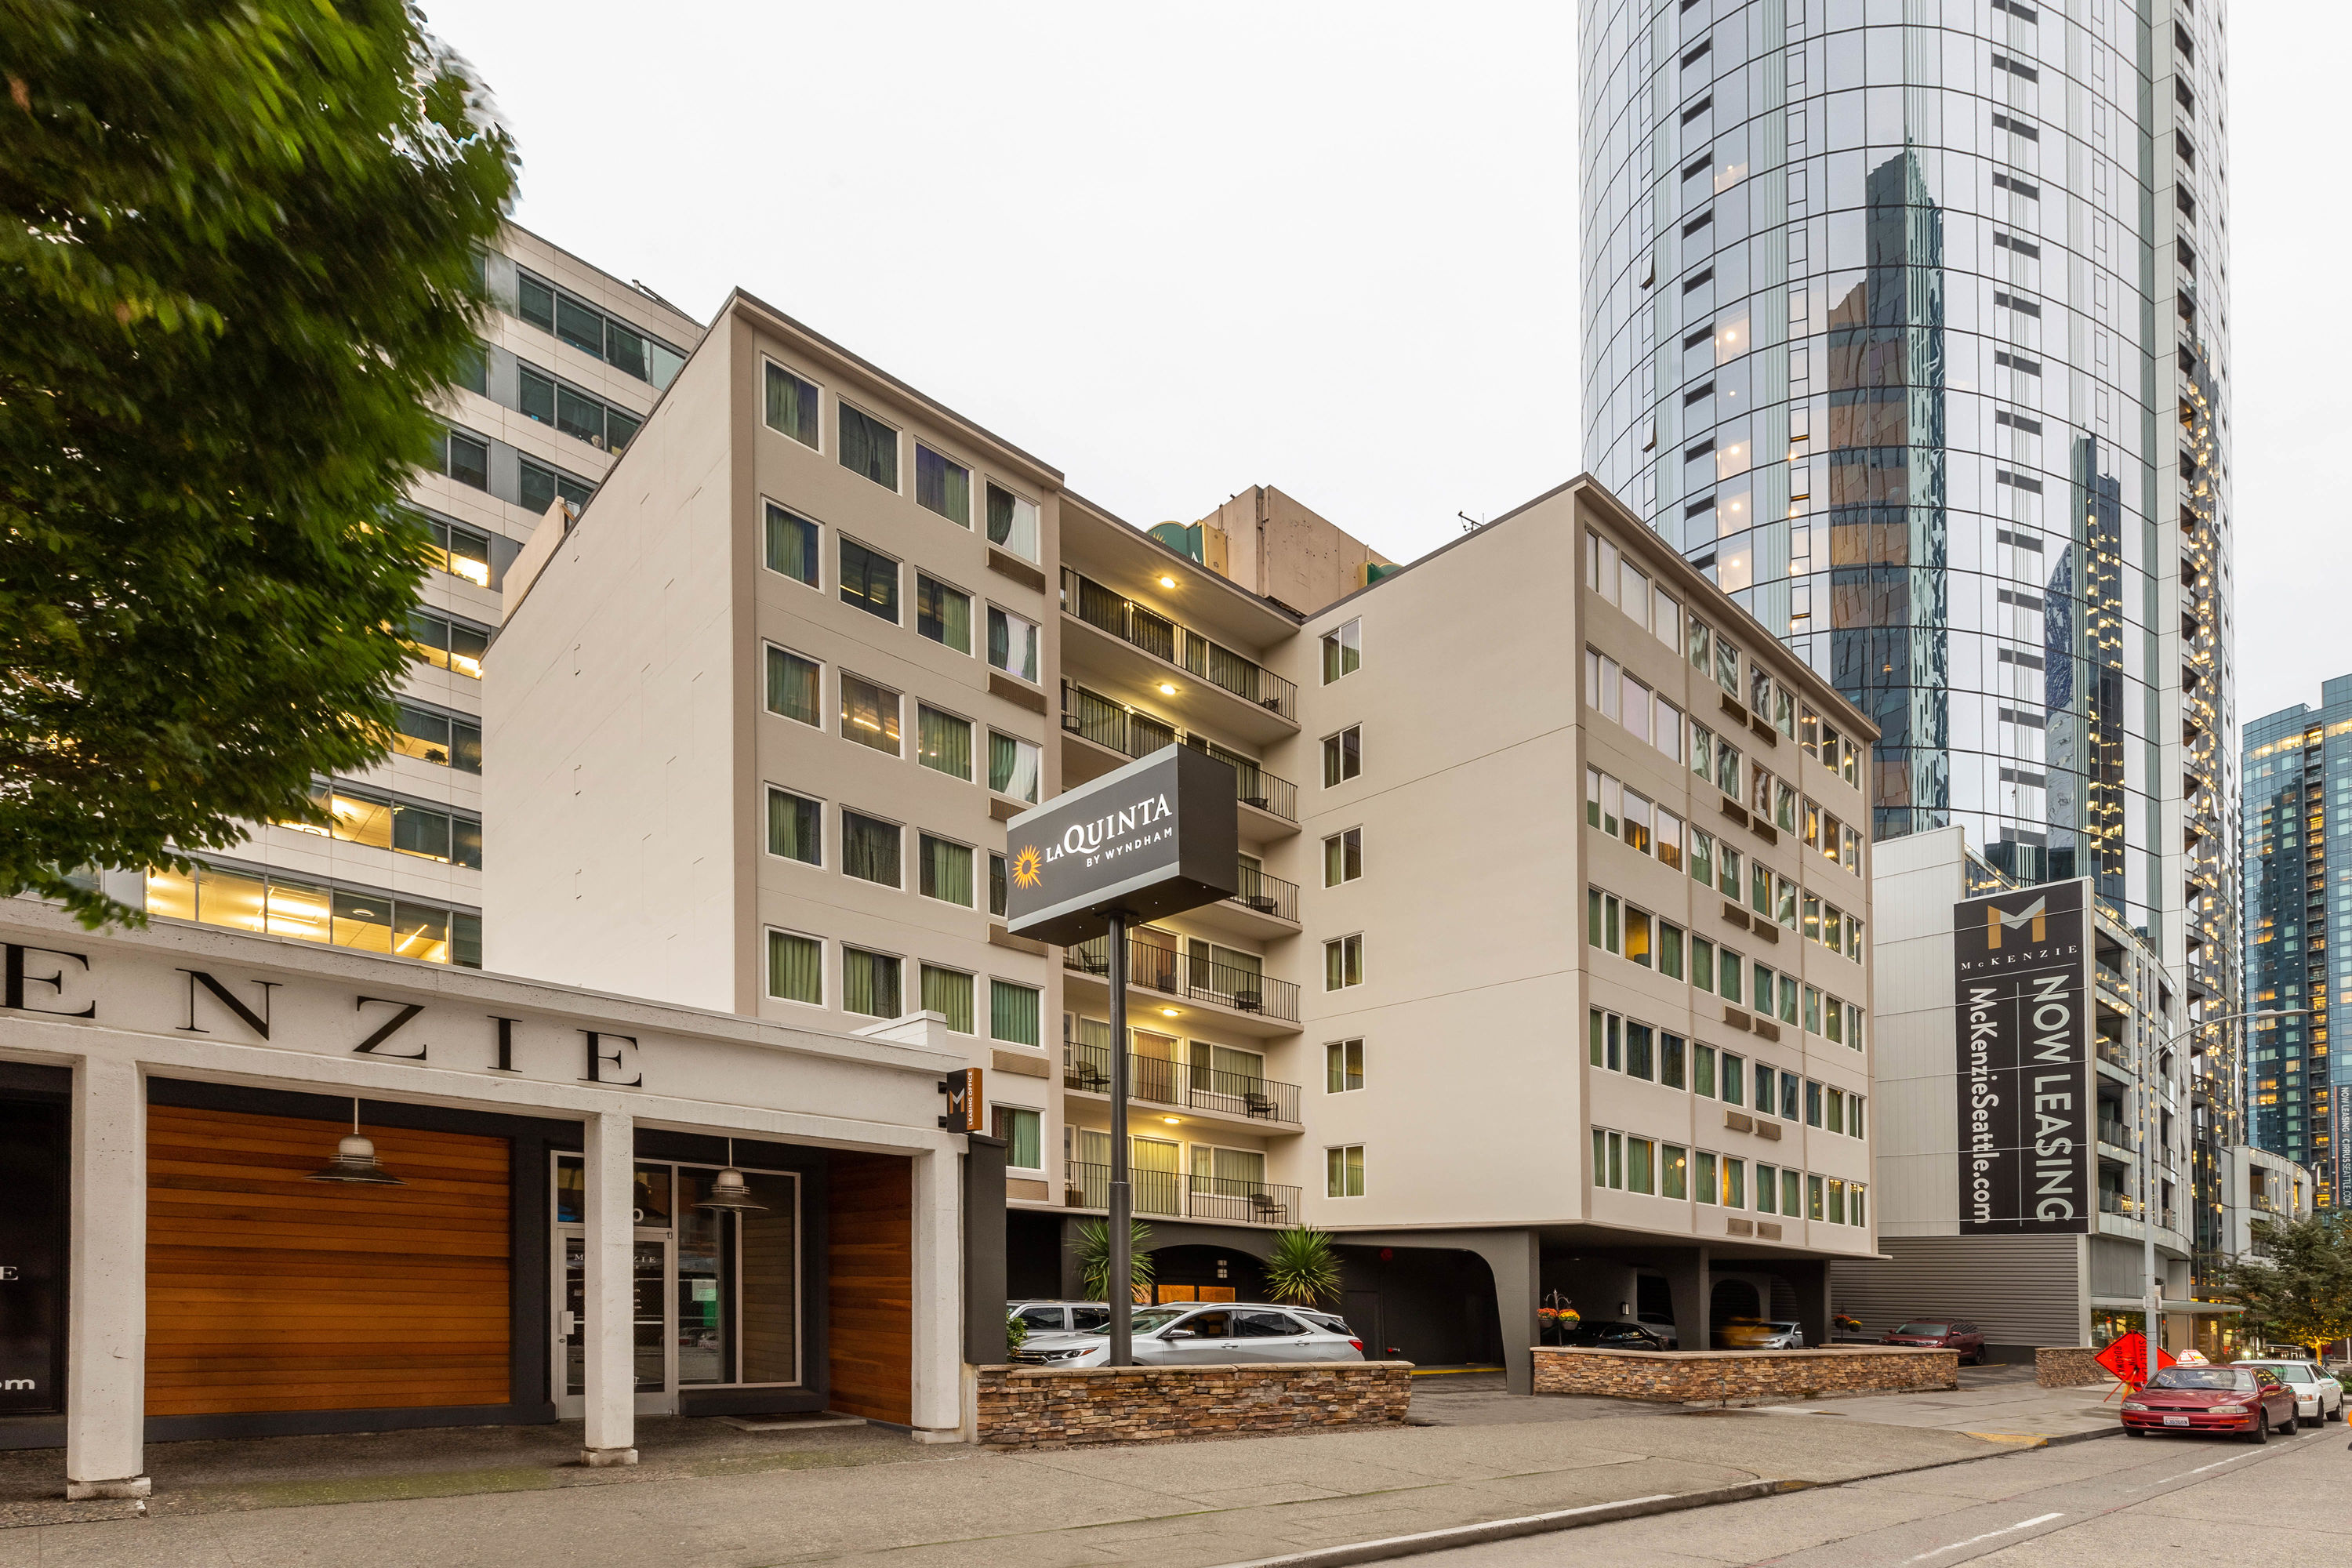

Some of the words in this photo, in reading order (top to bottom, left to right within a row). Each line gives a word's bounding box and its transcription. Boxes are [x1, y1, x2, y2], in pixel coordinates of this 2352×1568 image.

[1086, 855, 1100, 867] BY
[1105, 827, 1172, 860] WYNDHAM
[1961, 945, 2077, 970] McKENZIE
[2033, 975, 2070, 1062] NOW
[1969, 988, 1999, 1224] McKenzieSeattle.com
[2341, 1087, 2350, 1103] NOW
[2341, 1105, 2350, 1132] LEASING
[2034, 1074, 2074, 1221] LEASING
